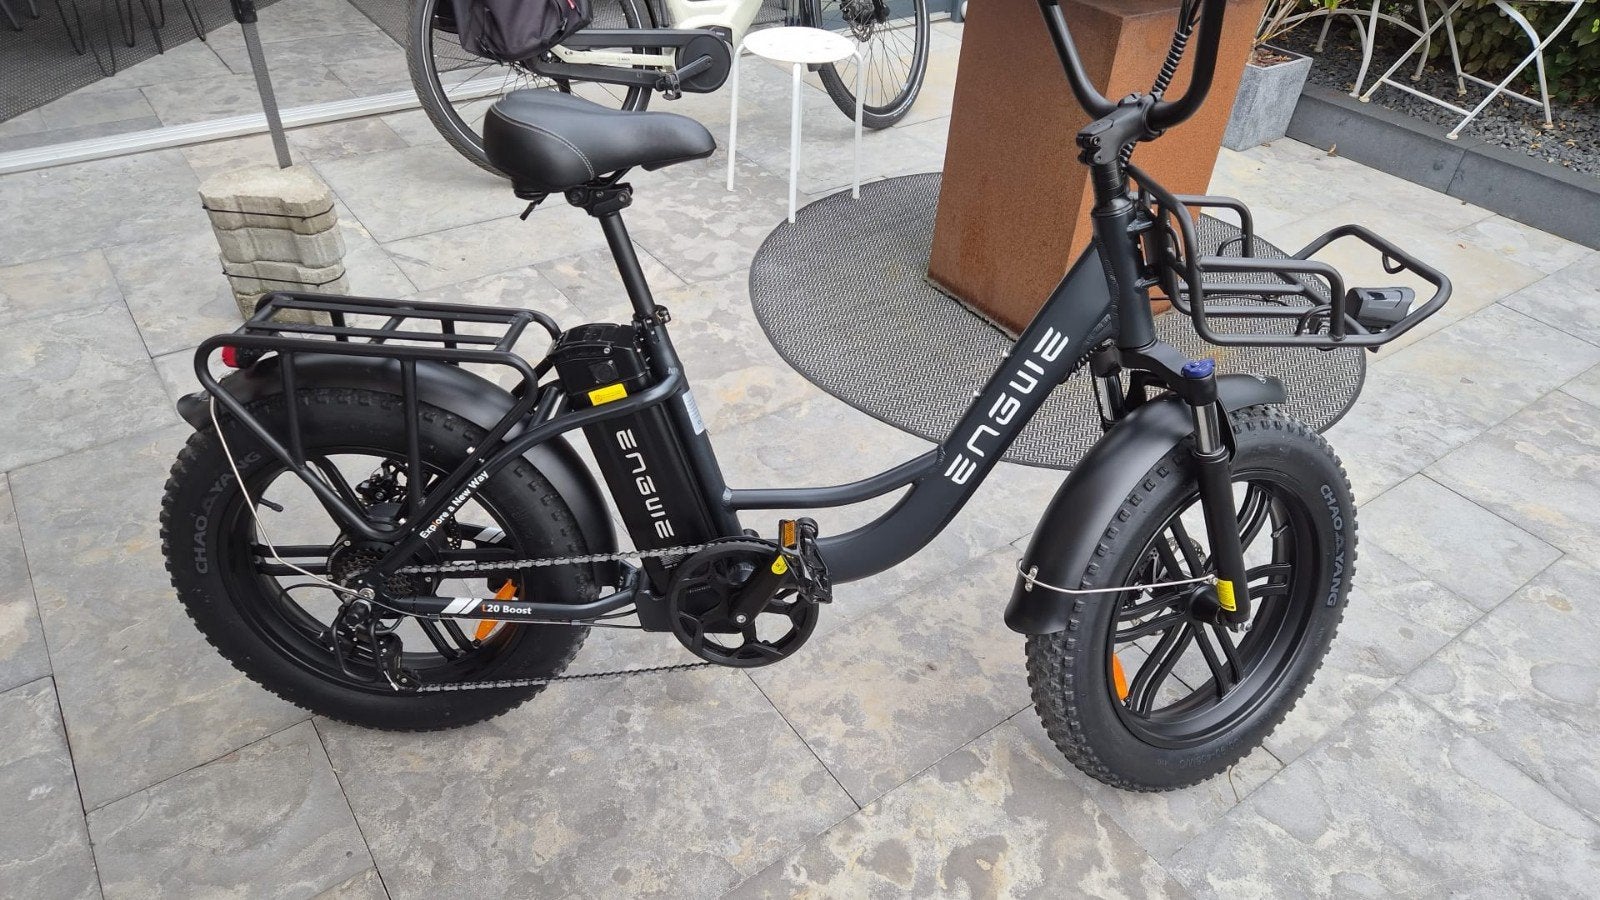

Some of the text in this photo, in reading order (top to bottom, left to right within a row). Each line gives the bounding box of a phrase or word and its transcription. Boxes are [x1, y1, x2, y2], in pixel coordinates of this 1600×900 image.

[419, 511, 450, 539] Explore
[451, 488, 471, 506] New
[468, 470, 489, 489] Way
[481, 604, 532, 615] L20 Boost
